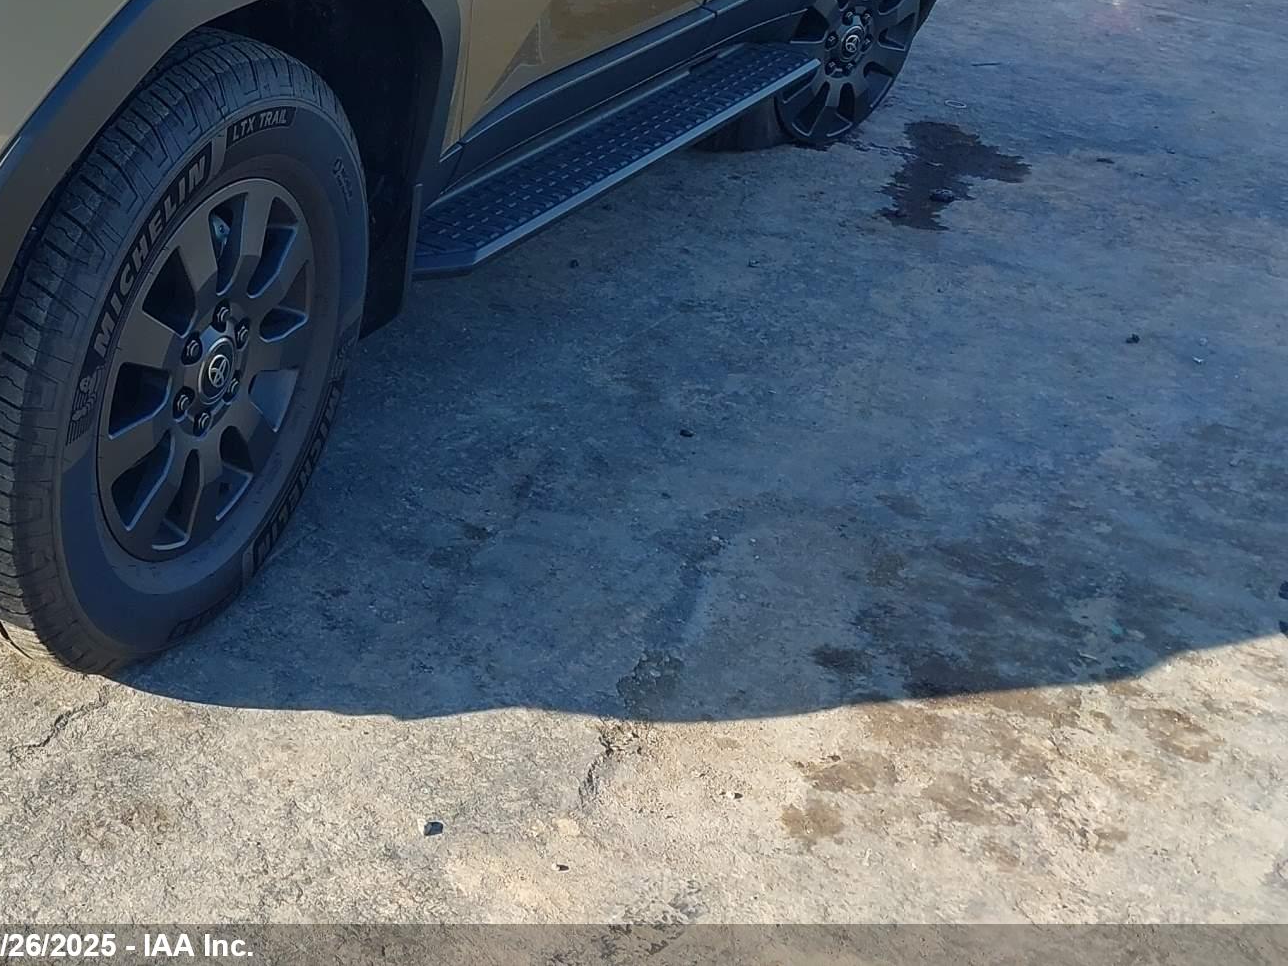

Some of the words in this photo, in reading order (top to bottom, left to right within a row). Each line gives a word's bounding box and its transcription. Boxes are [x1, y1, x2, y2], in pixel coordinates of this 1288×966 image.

[232, 117, 255, 141] LTX
[259, 108, 288, 127] TRAIL
[92, 155, 208, 356] MICHELIN
